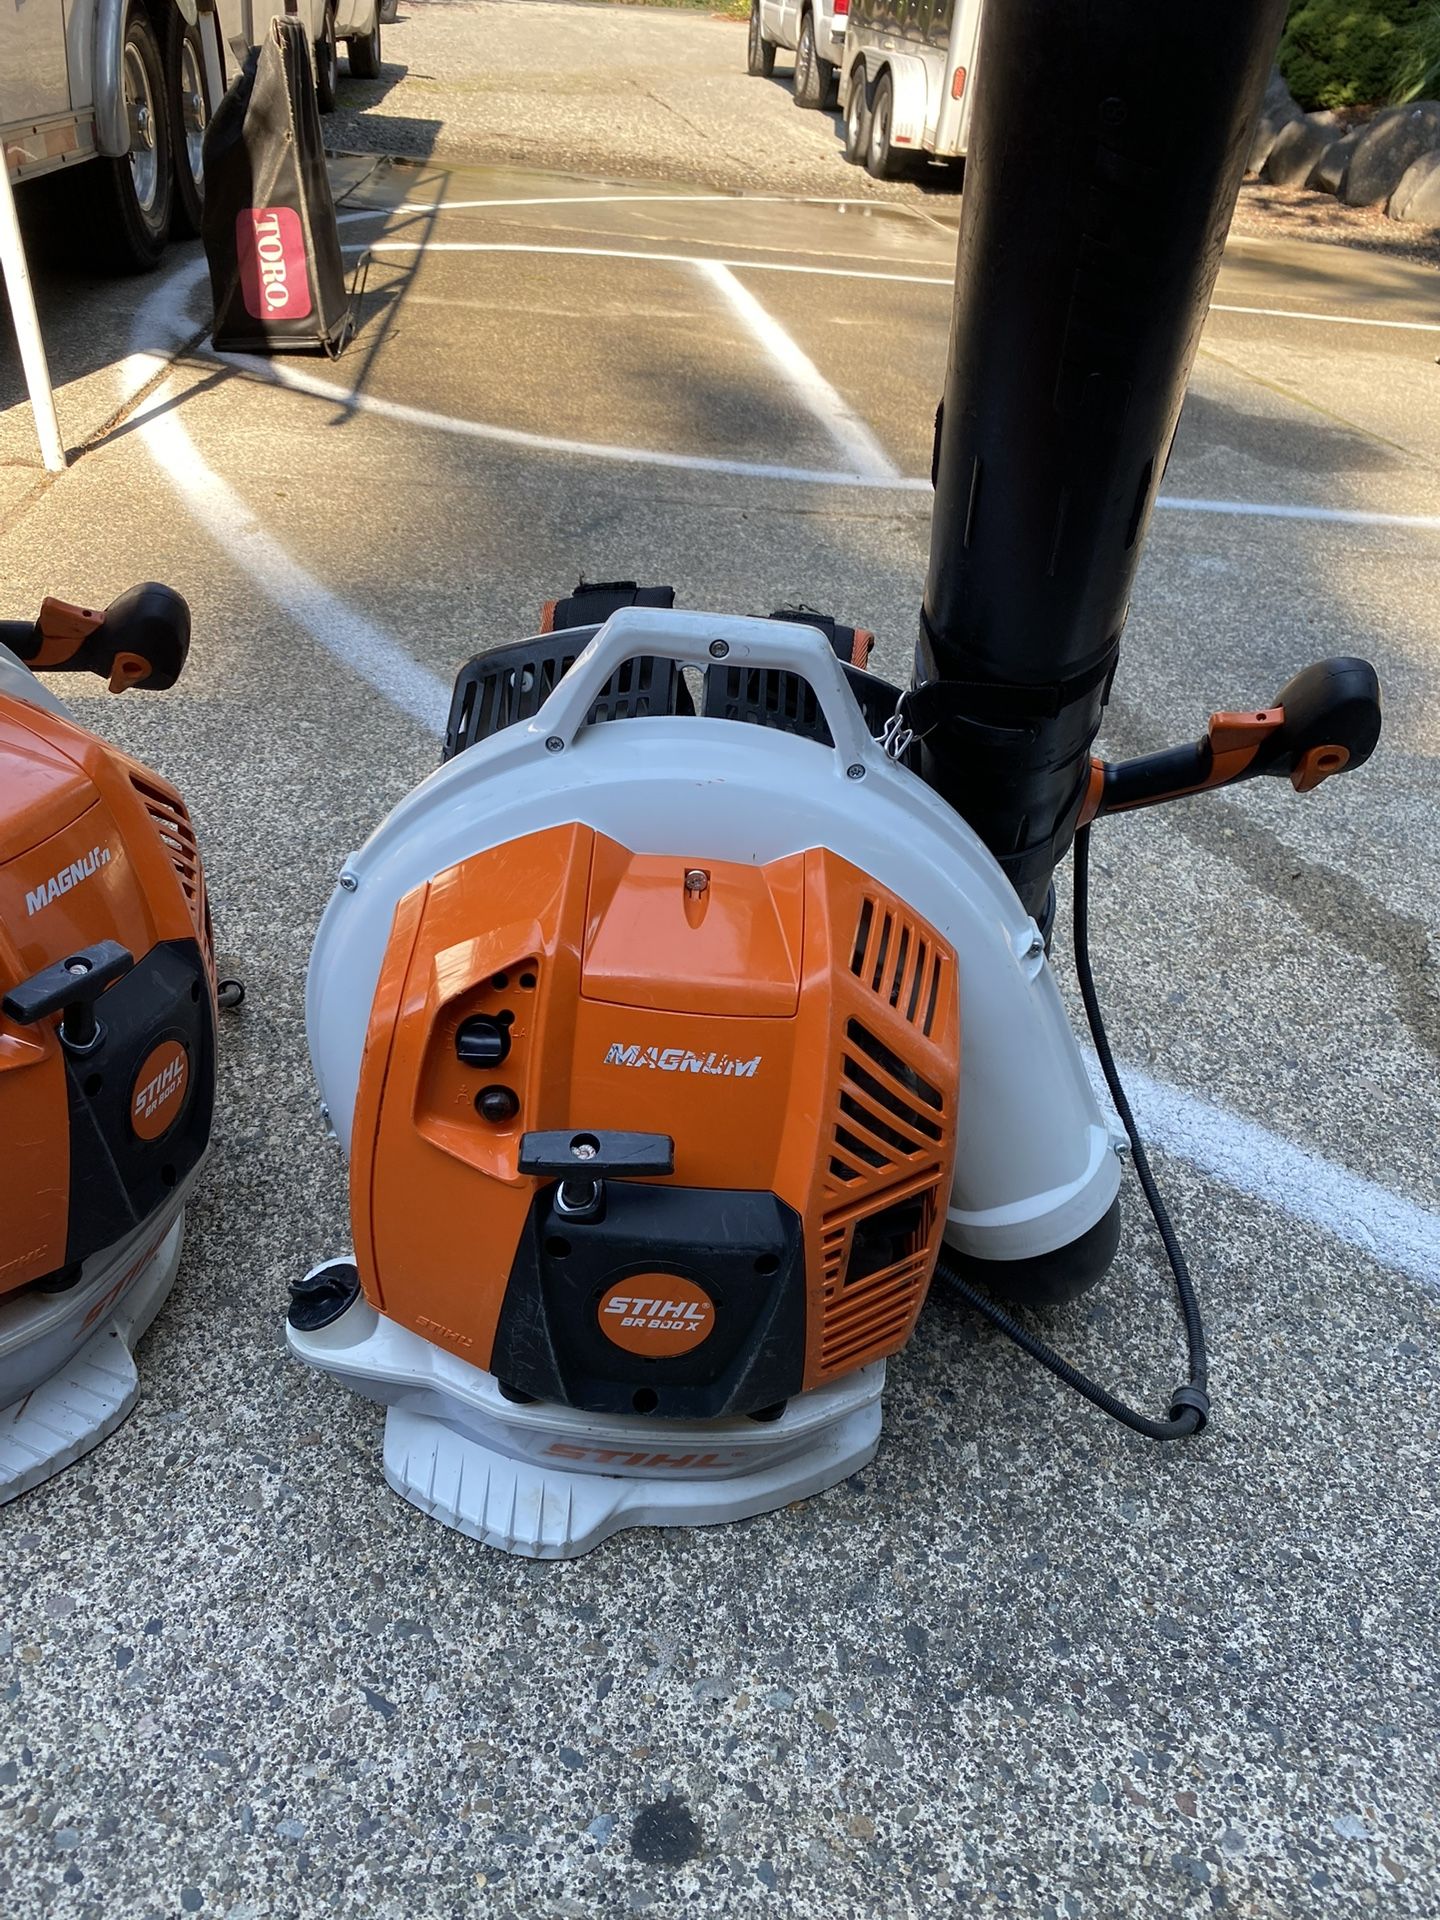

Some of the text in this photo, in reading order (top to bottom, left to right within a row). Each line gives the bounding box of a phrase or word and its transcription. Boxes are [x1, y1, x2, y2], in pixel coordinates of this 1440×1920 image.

[603, 1043, 762, 1077] MAGNUM
[604, 1296, 706, 1320] STIHL
[621, 1317, 700, 1332] BR 800 X
[543, 1443, 733, 1468] STIHL
